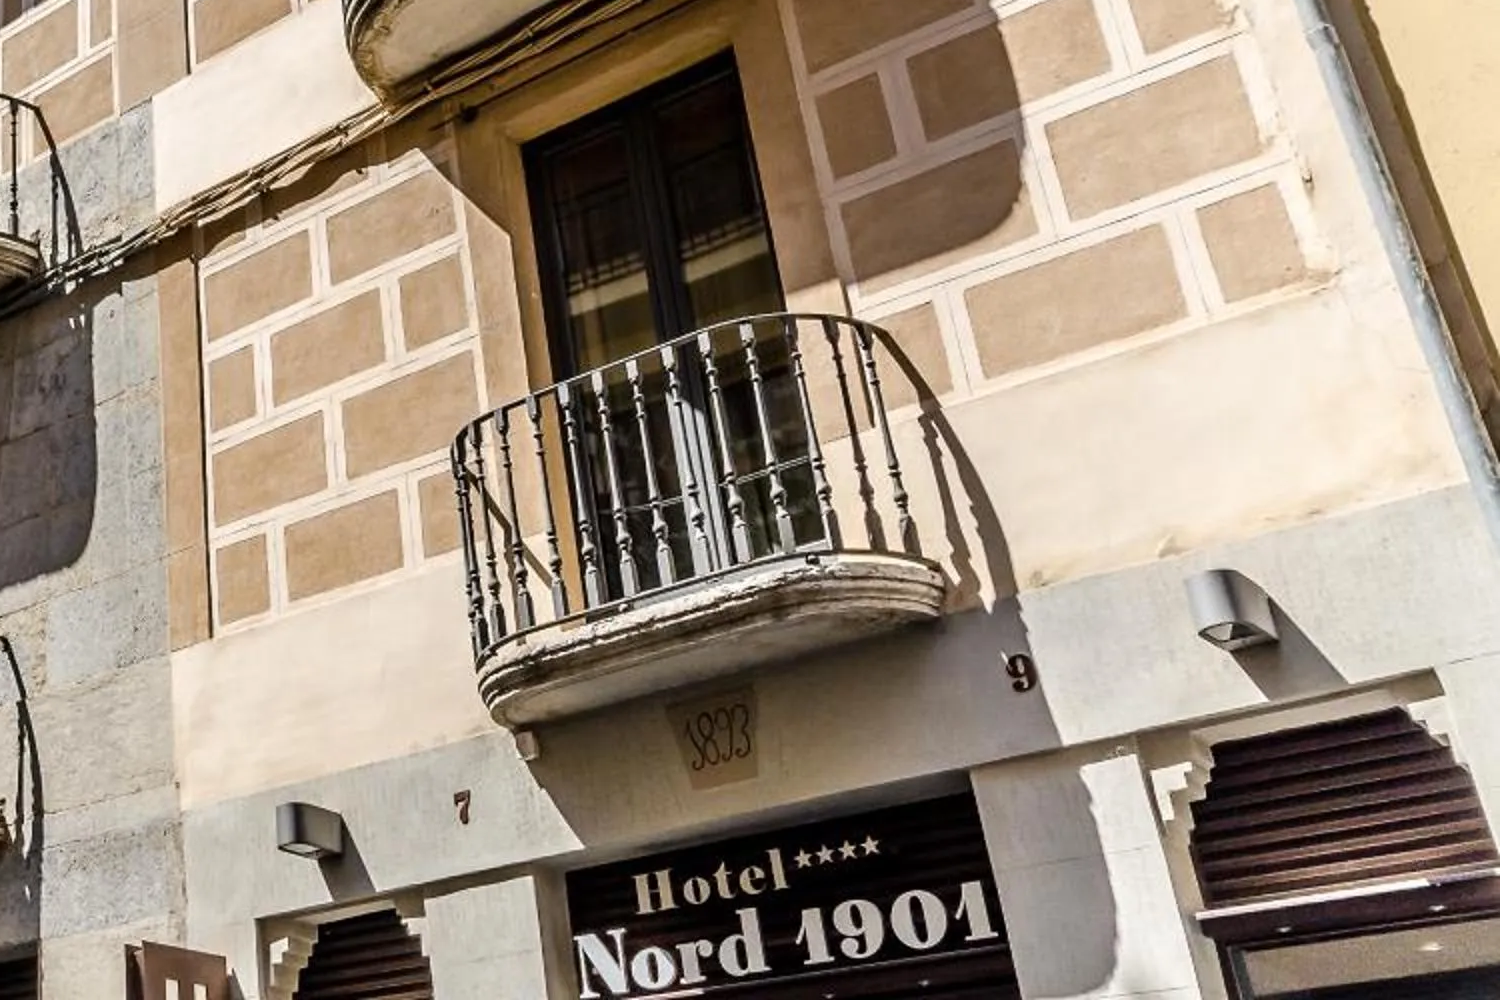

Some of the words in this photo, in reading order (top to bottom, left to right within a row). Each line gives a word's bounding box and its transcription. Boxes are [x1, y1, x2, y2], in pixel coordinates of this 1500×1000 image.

[1005, 653, 1037, 693] 9
[453, 789, 471, 825] 7
[632, 847, 791, 915] Hotel
[572, 906, 773, 1000] Nord
[795, 879, 1000, 967] 1901
